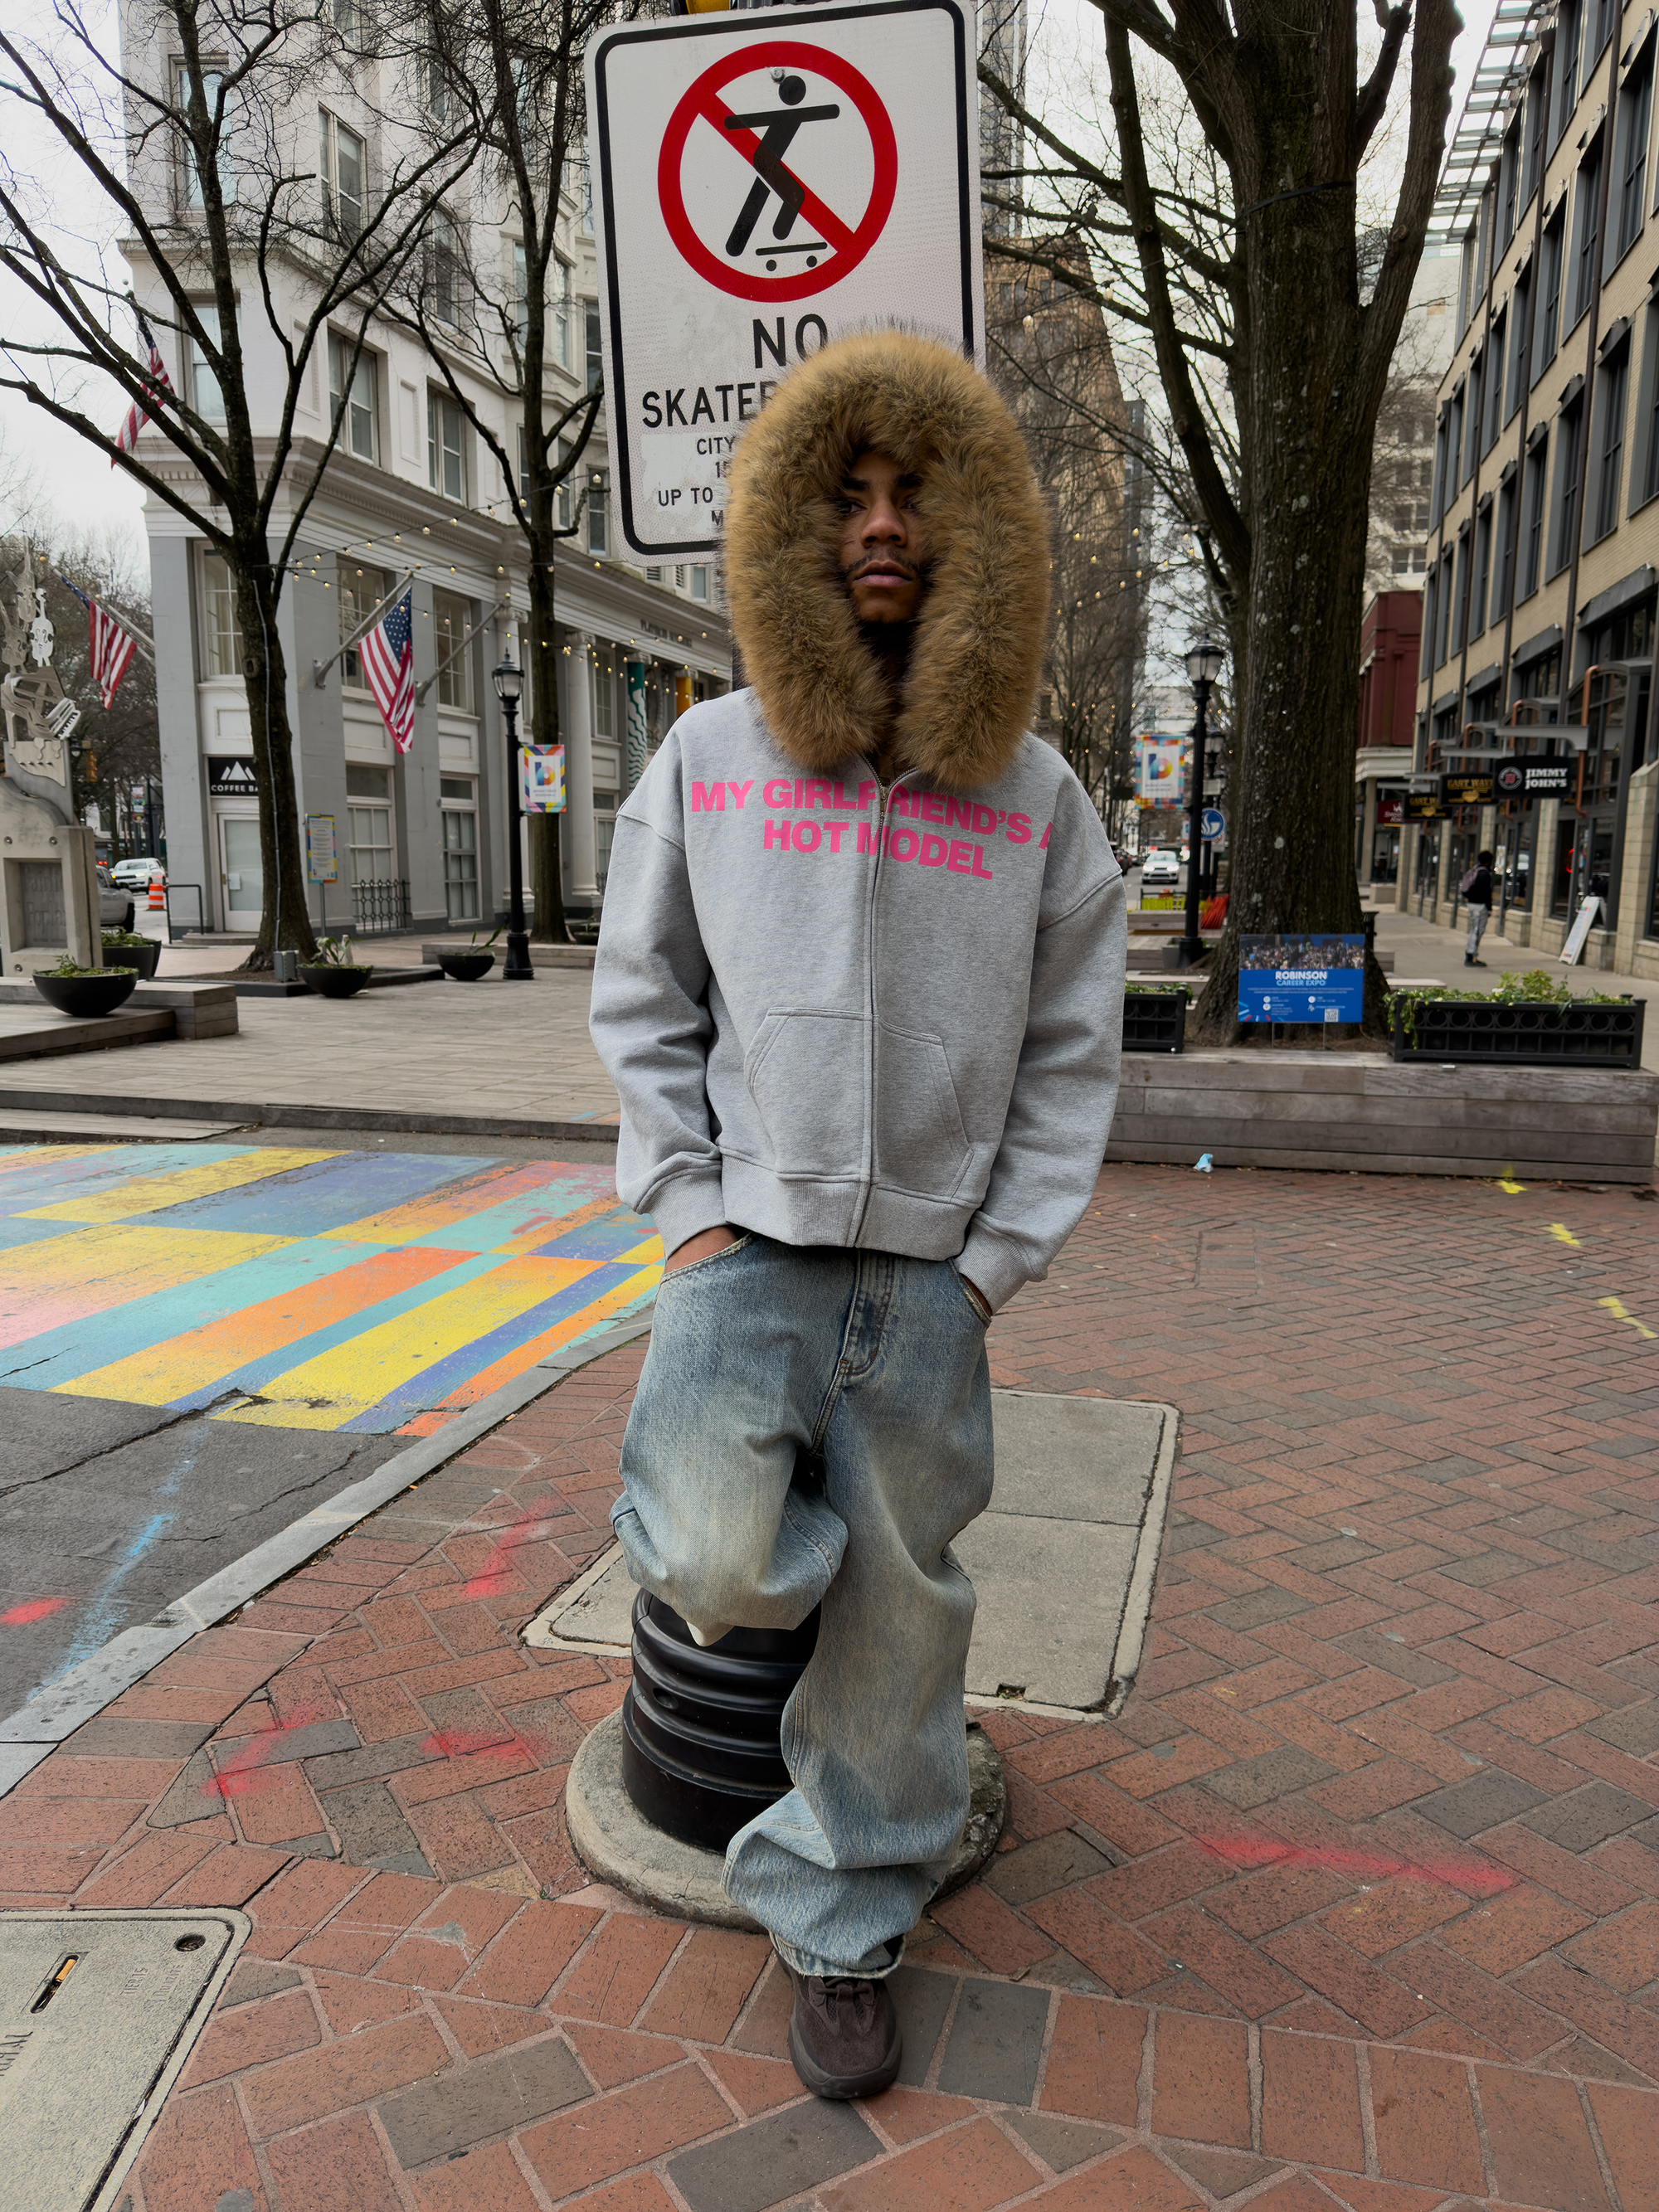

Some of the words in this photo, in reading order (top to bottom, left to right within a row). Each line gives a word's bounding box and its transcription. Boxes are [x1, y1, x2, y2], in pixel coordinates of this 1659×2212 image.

[752, 314, 828, 369] NO
[697, 435, 735, 455] CITY
[659, 489, 682, 507] UP
[691, 487, 713, 504] TO
[1525, 768, 1568, 779] JIMMY
[1447, 779, 1470, 789] EAST
[1525, 779, 1568, 790] JOHN'S
[691, 780, 754, 813] MY
[762, 778, 1032, 844] GIRLFRIEND'S
[763, 819, 849, 853] HOT
[856, 822, 993, 880] MODEL
[1275, 970, 1328, 980] ROBINSON
